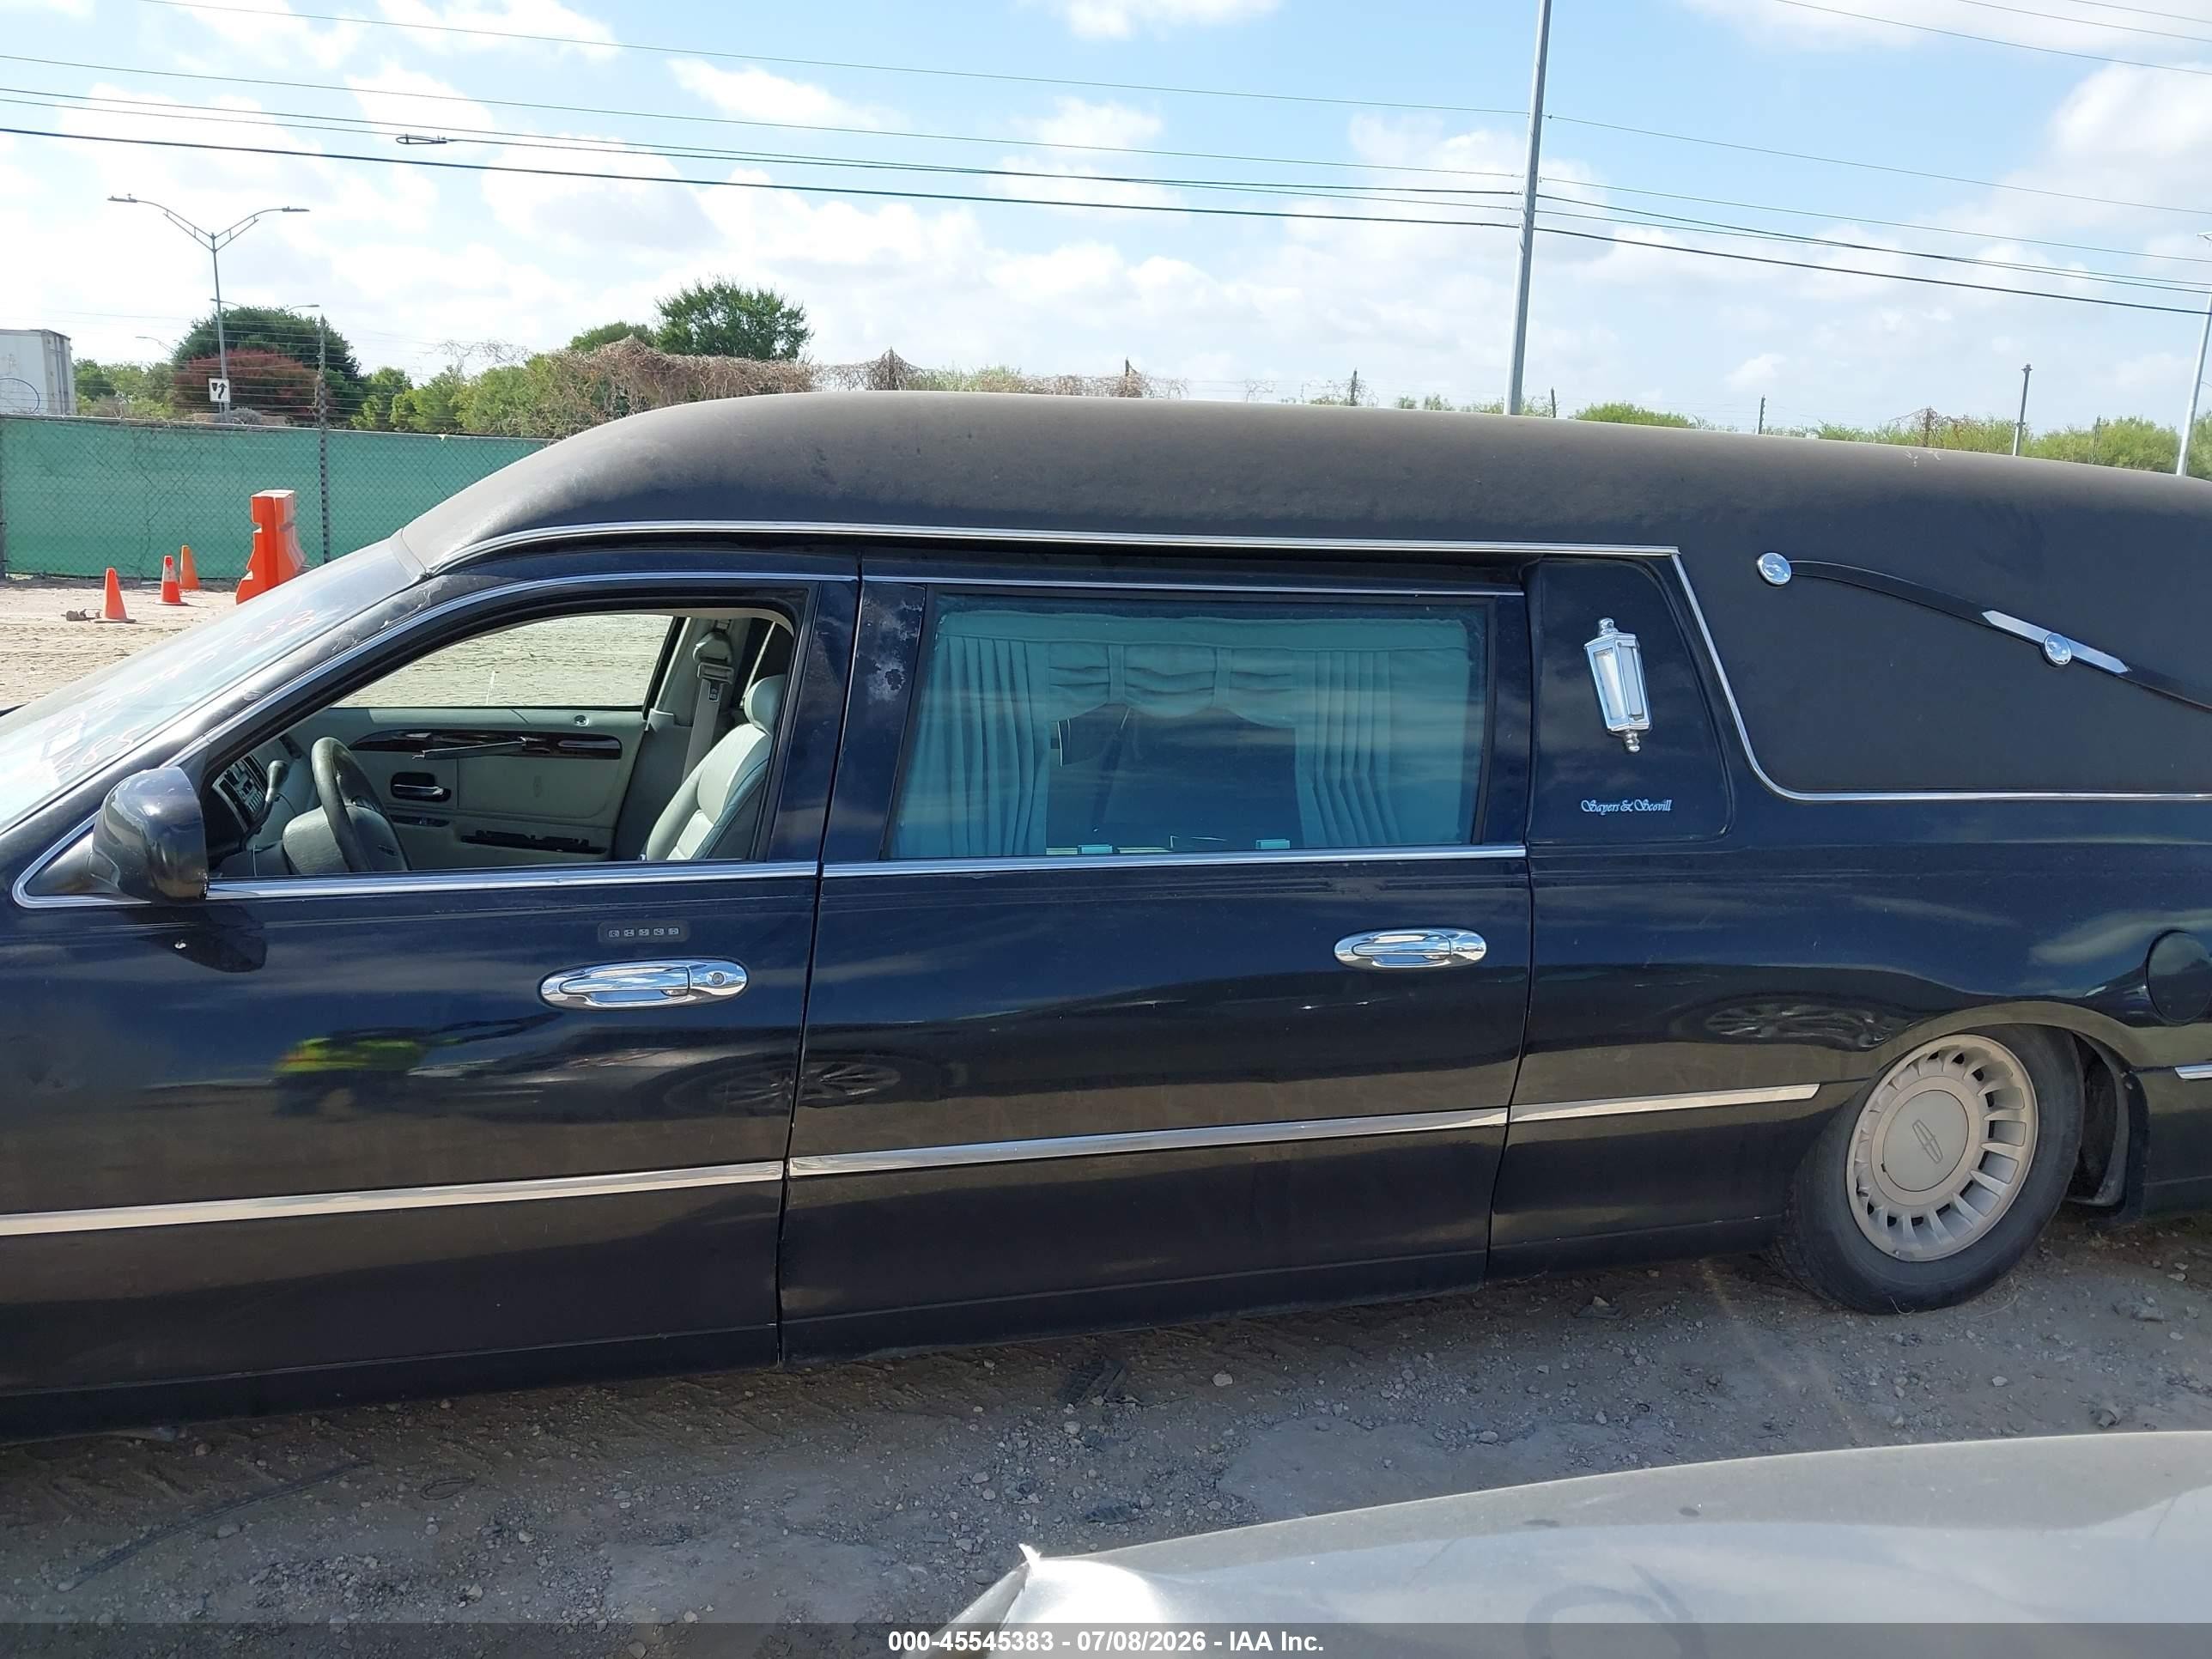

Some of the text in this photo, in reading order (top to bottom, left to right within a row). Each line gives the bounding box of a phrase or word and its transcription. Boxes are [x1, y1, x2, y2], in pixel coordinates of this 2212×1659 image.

[1581, 799, 1672, 815] Sayers & Scovill
